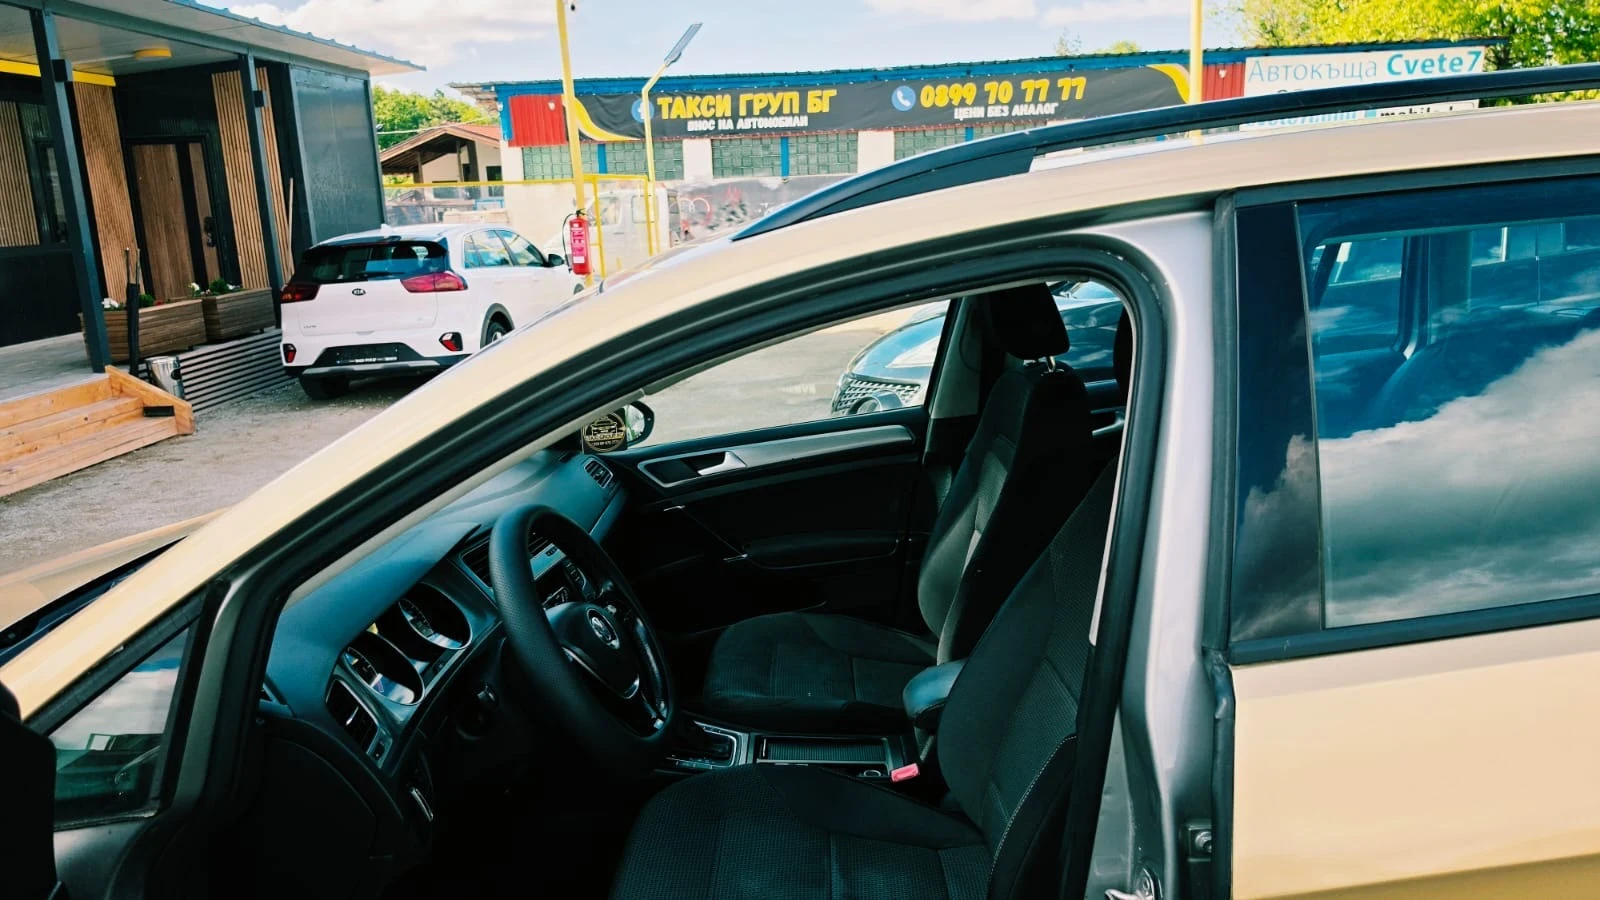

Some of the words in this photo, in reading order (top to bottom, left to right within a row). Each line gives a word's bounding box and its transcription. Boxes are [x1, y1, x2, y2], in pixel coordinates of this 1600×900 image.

[1248, 59, 1377, 83] Автокъща
[657, 95, 732, 120] ТАКСИ
[739, 91, 800, 117] ГРУП
[807, 89, 837, 114] БГ
[920, 83, 977, 108] 0899
[984, 81, 1014, 105] 70
[1021, 79, 1050, 103] 77
[1057, 77, 1087, 101] 77
[954, 107, 985, 121] ЦЕНИ
[987, 105, 1010, 118] БЕЗ
[1011, 102, 1059, 117] АНАЛОГ
[718, 117, 734, 131] НА
